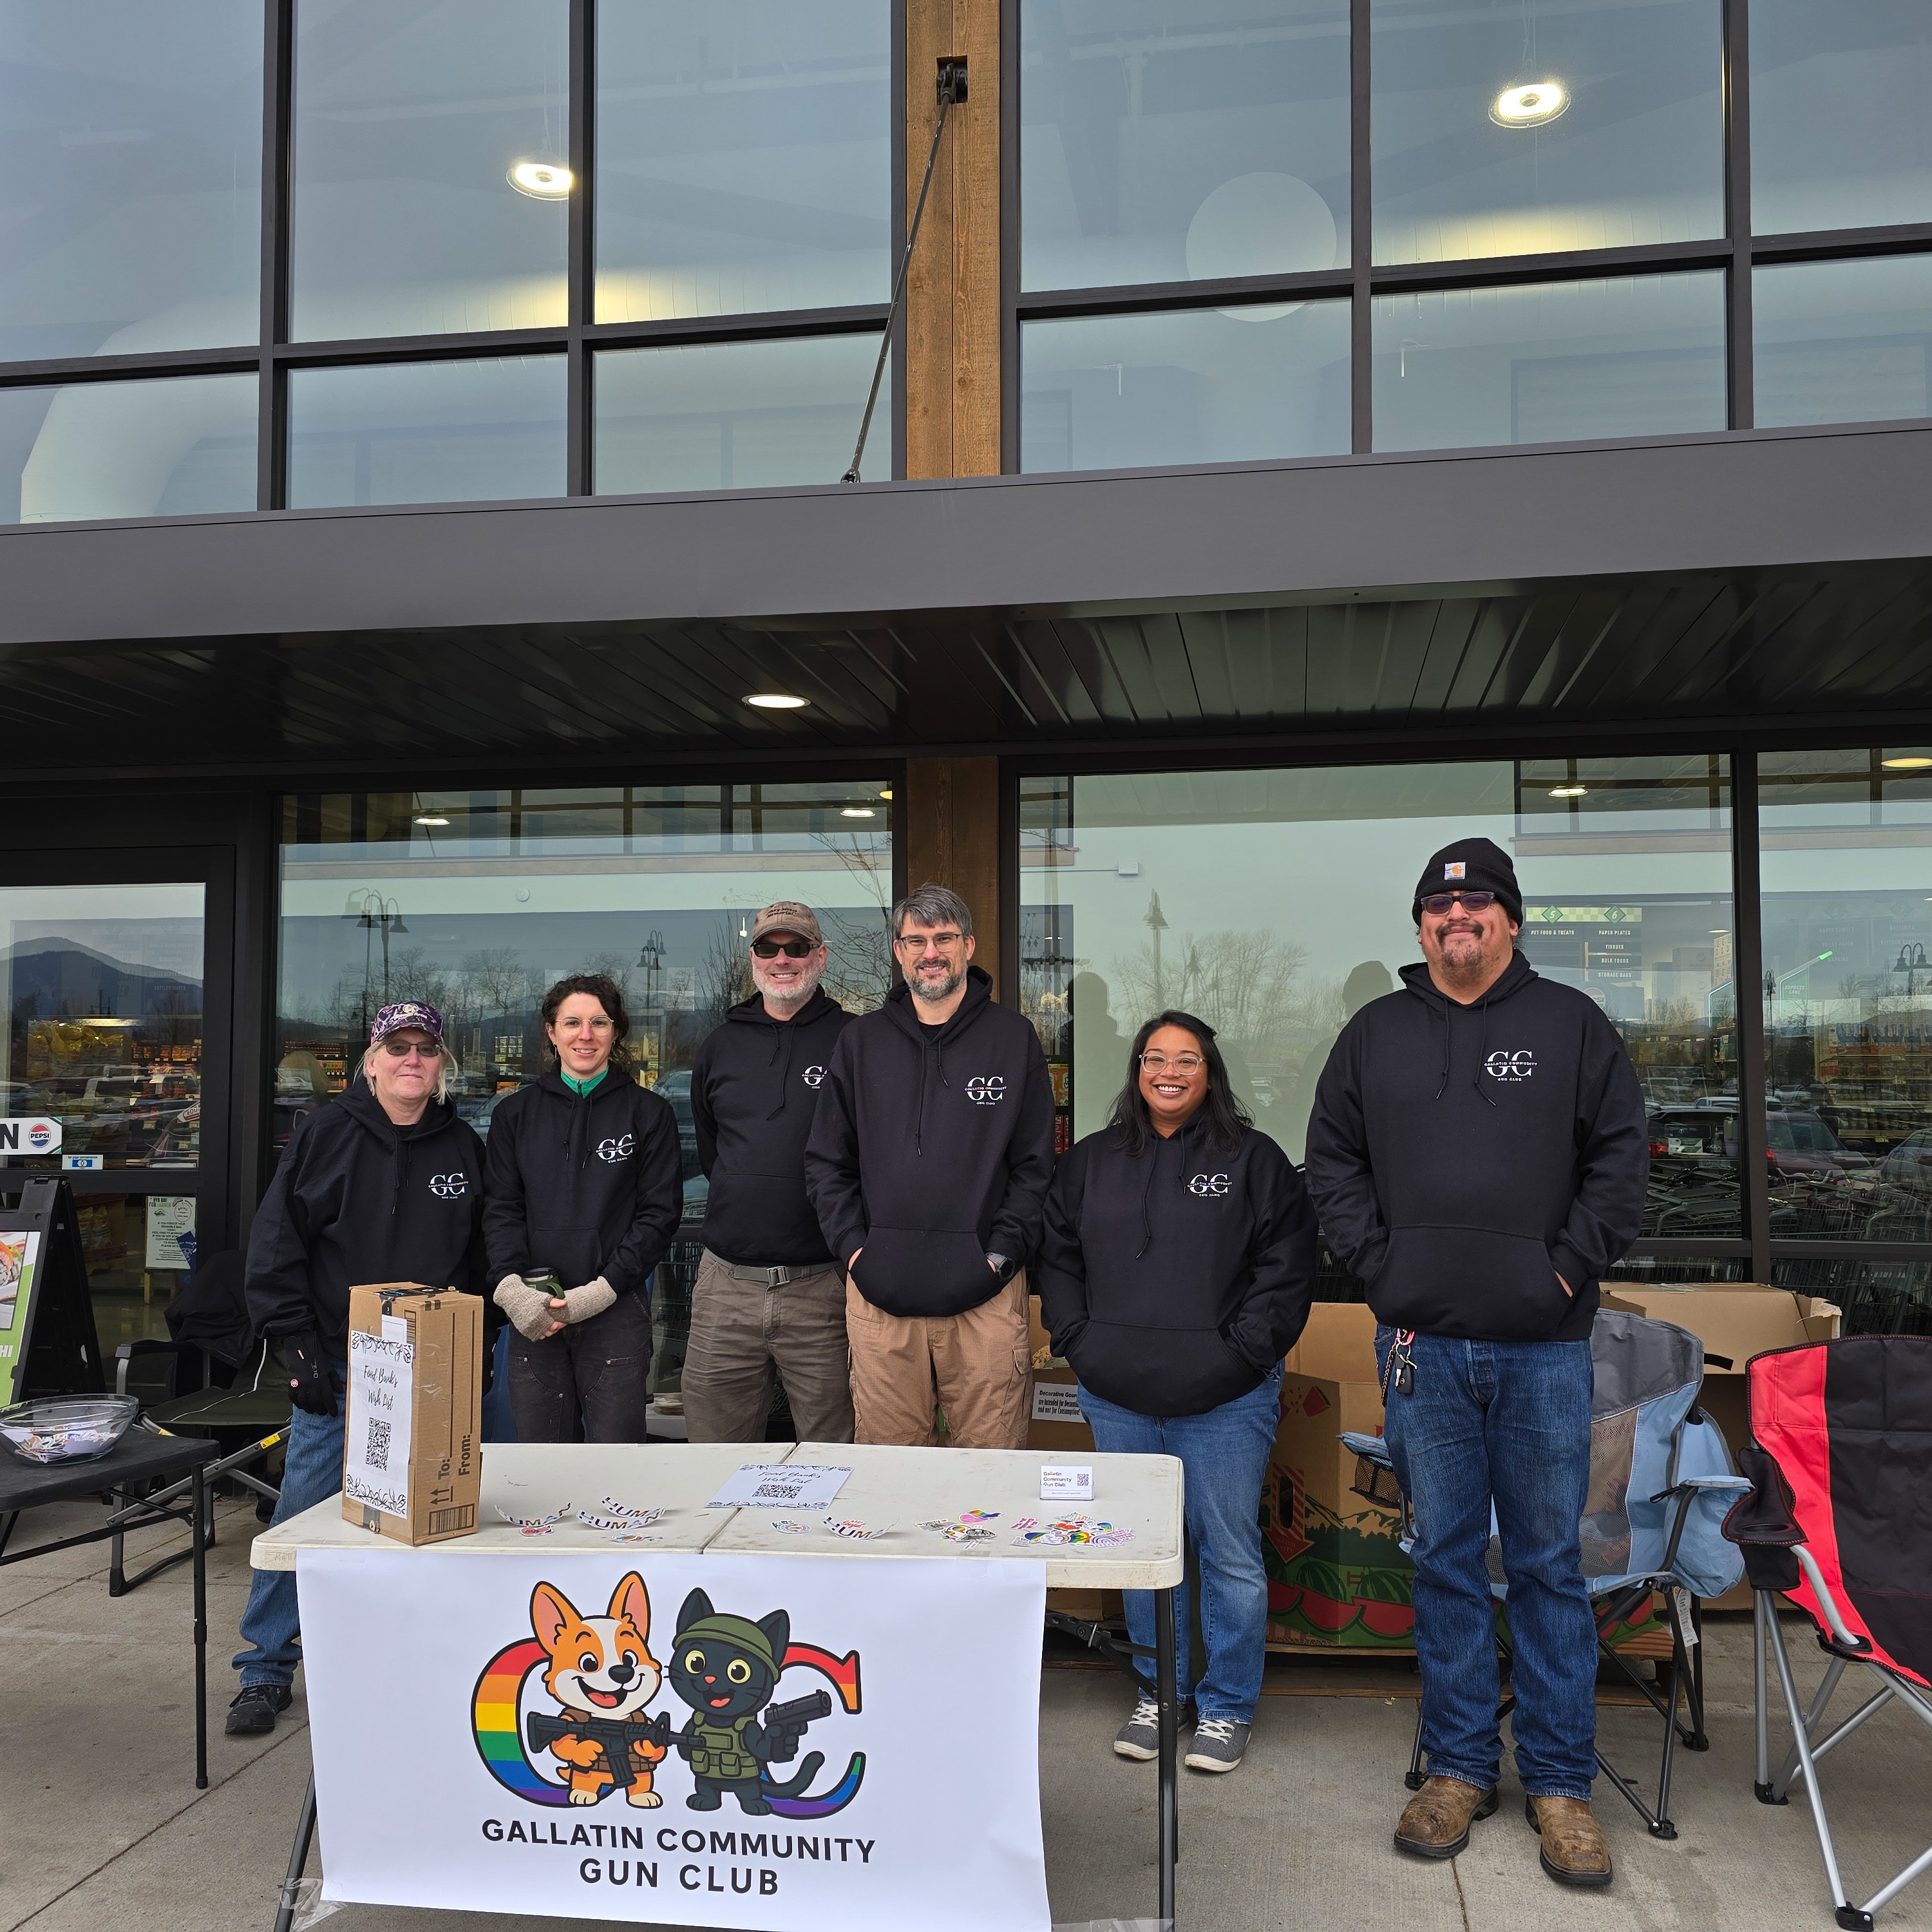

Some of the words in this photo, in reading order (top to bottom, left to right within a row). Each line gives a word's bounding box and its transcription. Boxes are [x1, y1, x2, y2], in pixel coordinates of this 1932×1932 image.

[1549, 910, 1556, 919] 5
[1611, 910, 1618, 920] 6
[1486, 1050, 1532, 1077] GC
[967, 1076, 1003, 1101] GC
[598, 1133, 633, 1160] GC
[430, 1172, 465, 1196] GC
[1189, 1173, 1228, 1193] GC
[364, 1365, 378, 1381] Food
[378, 1368, 398, 1388] Bank's
[368, 1388, 381, 1406] Wish
[383, 1392, 393, 1411] List
[459, 1434, 471, 1476] From:
[438, 1459, 450, 1481] To:
[1276, 1537, 1296, 1548] WATCH
[482, 1819, 643, 1850] GALLATIN
[656, 1827, 876, 1864] COMMUNITY
[580, 1858, 658, 1888] GUN
[679, 1864, 779, 1895] CLUB
